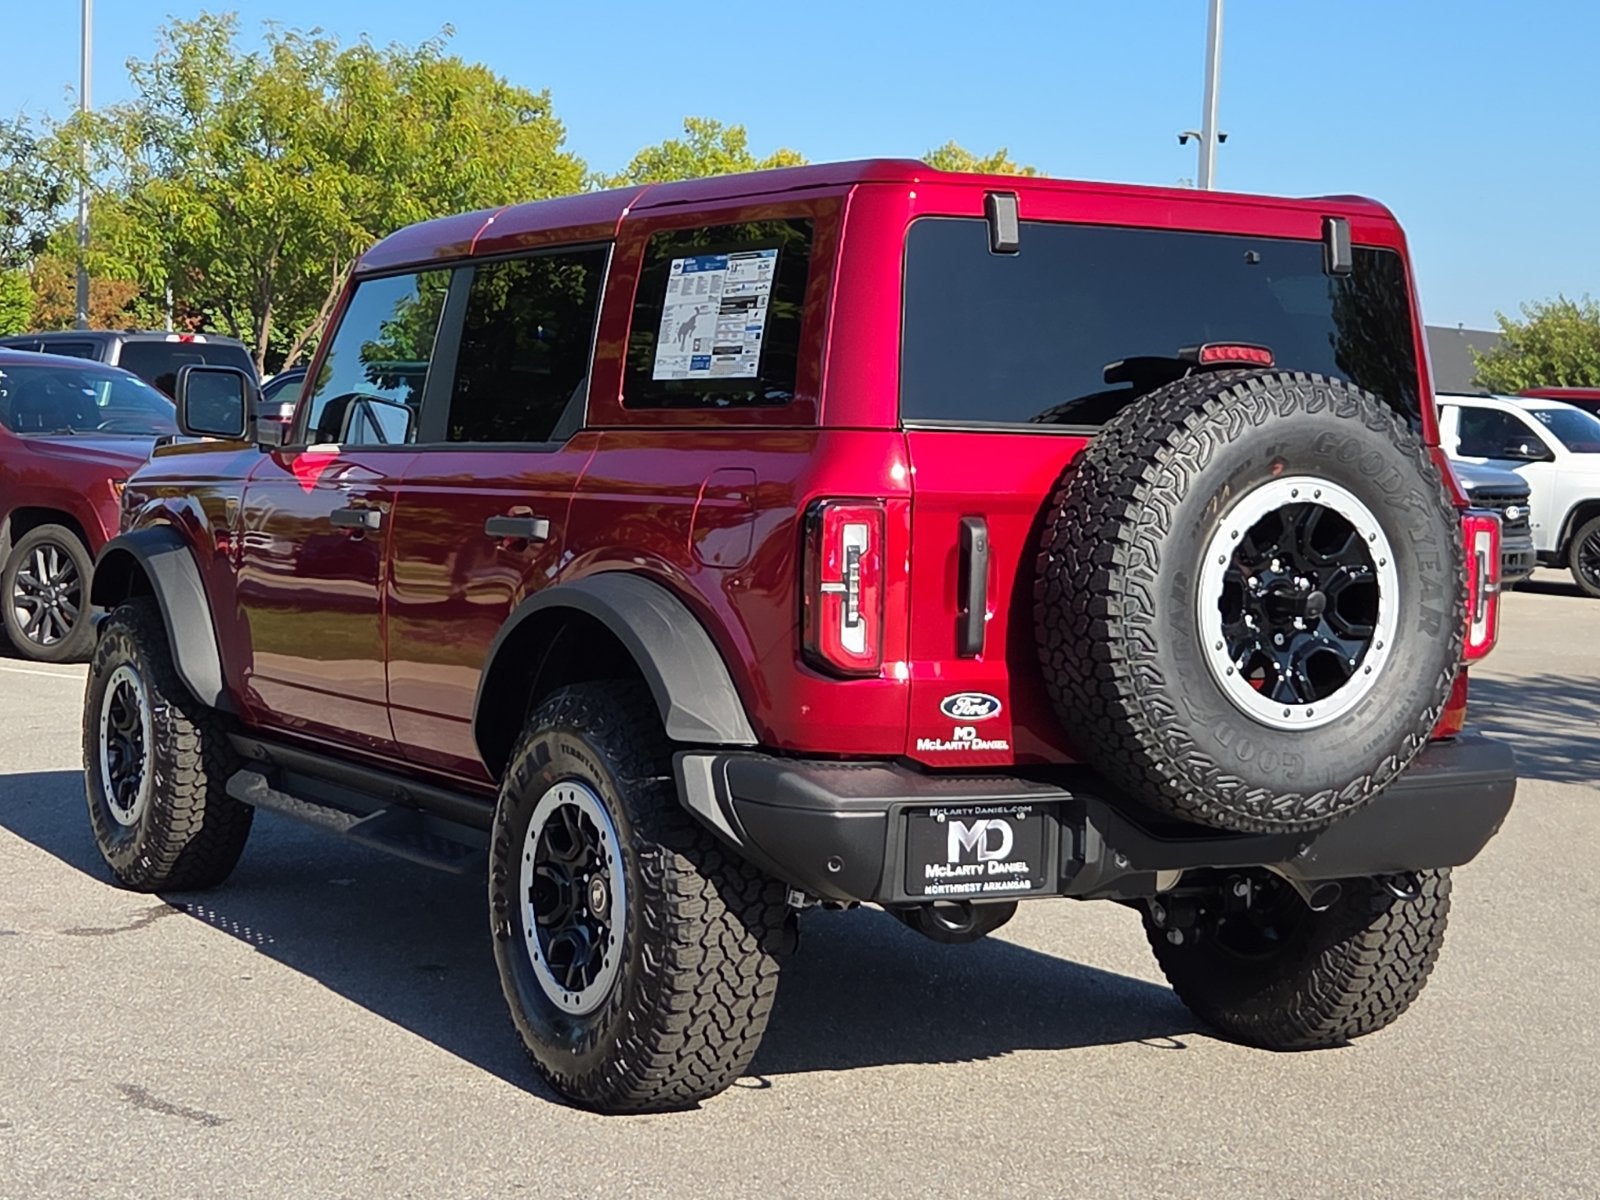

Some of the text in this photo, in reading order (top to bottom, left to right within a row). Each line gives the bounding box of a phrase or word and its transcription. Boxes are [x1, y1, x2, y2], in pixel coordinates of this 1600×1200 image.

[1312, 431, 1442, 637] GOODYEAR
[952, 697, 989, 717] Ford
[954, 727, 976, 740] MD
[948, 819, 1014, 863] MD
[924, 880, 1031, 895] NORTHWEST ARKANSAS
